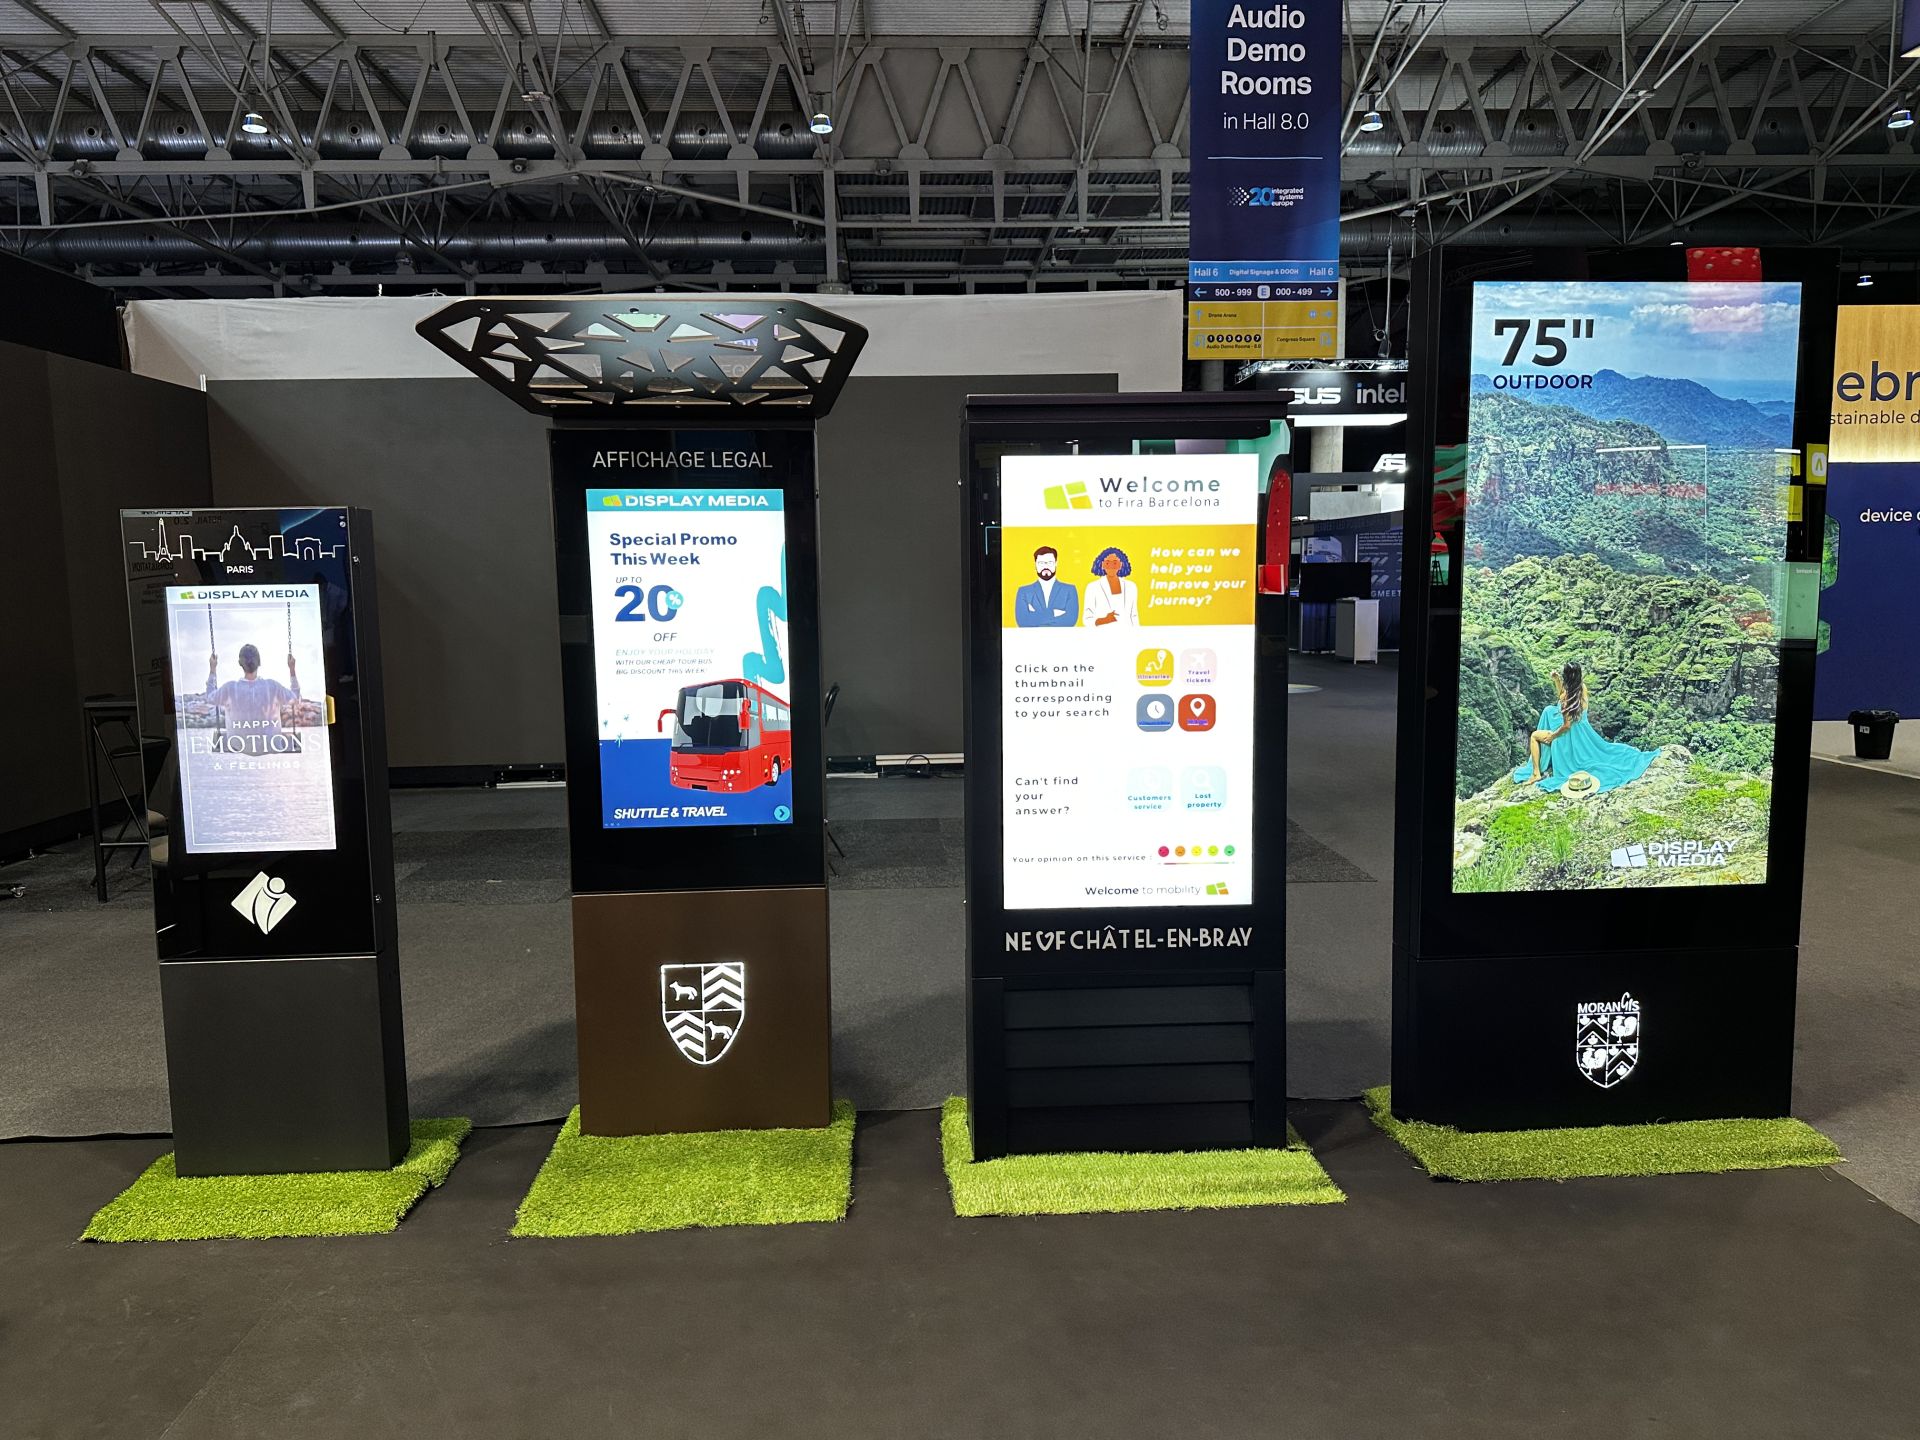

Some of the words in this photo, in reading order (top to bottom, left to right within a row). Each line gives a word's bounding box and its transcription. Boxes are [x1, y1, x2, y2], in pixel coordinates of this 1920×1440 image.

[1227, 4, 1306, 29] Audio
[1227, 38, 1306, 62] Demo
[1221, 70, 1312, 95] Rooms
[1223, 112, 1238, 129] in
[1243, 112, 1275, 129] Hall
[1281, 112, 1309, 130] 8.0
[1249, 187, 1274, 206] 20
[1272, 187, 1304, 195] integrated
[1194, 268, 1211, 276] Hall
[1212, 268, 1218, 276] 6
[1229, 268, 1248, 276] Digital
[1250, 268, 1274, 276] Signage
[1236, 288, 1252, 296] 999
[1276, 288, 1290, 296] 000
[1297, 288, 1312, 296] 499
[1494, 319, 1595, 367] 75"
[1493, 374, 1593, 390] OUTDOOR
[1837, 361, 1920, 402] ebr
[1278, 387, 1342, 404] SUS
[593, 451, 705, 468] AFFICHAGE
[711, 451, 773, 468] LEGAL
[1100, 476, 1220, 493] Welcome
[626, 495, 704, 507] DISPLAY
[708, 495, 768, 506] MEDIA
[1100, 498, 1112, 508] to
[1118, 498, 1143, 508] Fira
[1149, 496, 1220, 508] Barcelona
[1860, 508, 1912, 522] device
[610, 533, 676, 548] Special
[680, 533, 737, 546] Promo
[610, 552, 648, 566] This
[650, 552, 700, 565] Week
[1151, 548, 1184, 558] How
[1188, 548, 1215, 557] can
[1220, 548, 1240, 557] we
[226, 566, 254, 574] PARIS
[1150, 563, 1182, 575] help
[1185, 564, 1213, 575] you
[616, 576, 628, 584] UP
[631, 576, 642, 584] TO
[1150, 579, 1210, 592] improve
[1213, 580, 1247, 591] your
[198, 590, 259, 600] DISPLAY
[262, 590, 309, 598] MEDIA
[1148, 594, 1213, 608] journey?
[653, 632, 677, 642] OFF
[648, 648, 674, 656] YOUR
[1015, 664, 1048, 673] Click
[1074, 664, 1095, 673] the
[1015, 678, 1084, 688] thumbnail
[1015, 693, 1112, 704] corresponding
[1015, 710, 1028, 718] to
[1032, 710, 1060, 719] your
[1066, 708, 1109, 717] search
[232, 720, 279, 728] HAPPY
[190, 734, 322, 754] EMOTIONS
[214, 762, 222, 770] &
[230, 761, 301, 770] FEELINGS
[1015, 777, 1048, 786] Can't
[1053, 776, 1078, 785] find
[1015, 793, 1043, 802] your
[614, 808, 669, 820] SHUTTLE
[671, 808, 679, 818] &
[682, 806, 727, 818] TRAVEL
[1015, 806, 1070, 815] answer?
[1648, 840, 1736, 854] DISPLAY
[1038, 855, 1073, 863] opinion
[1658, 853, 1726, 867] MEDIA
[1085, 886, 1139, 896] Welcome
[1142, 887, 1154, 895] to
[1156, 885, 1201, 896] mobility
[1577, 992, 1640, 1014] MORANGIS
